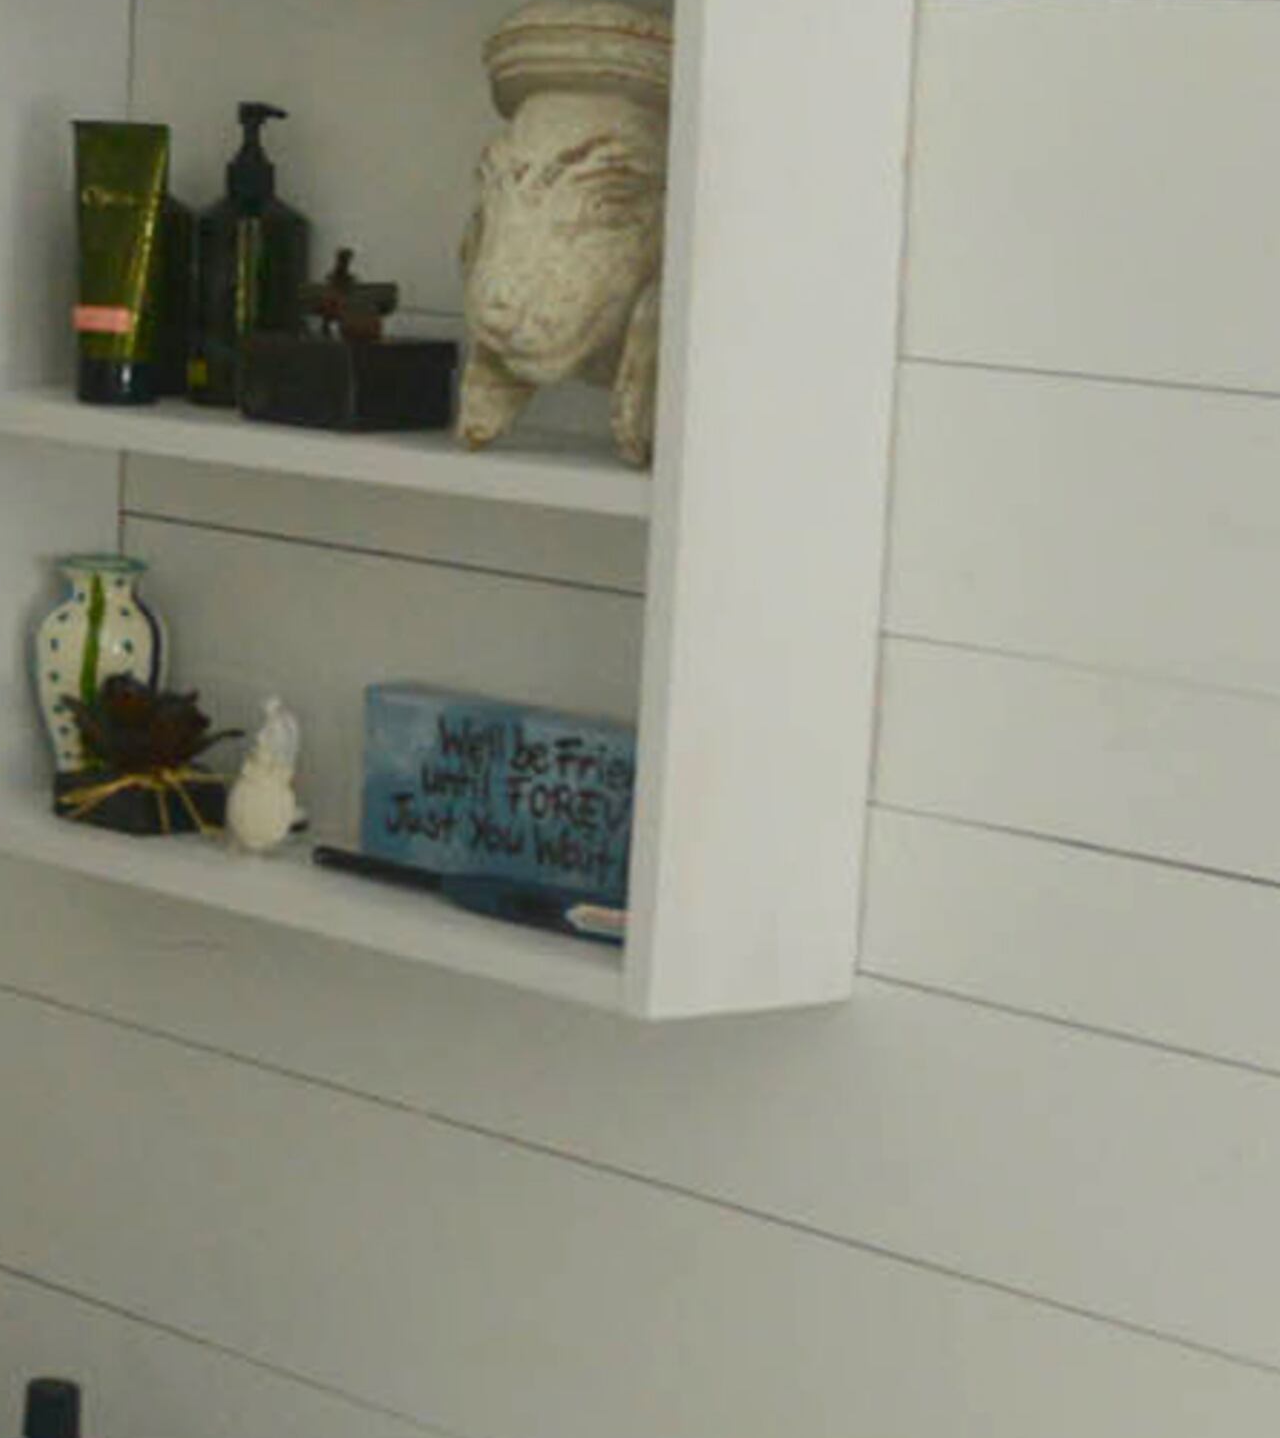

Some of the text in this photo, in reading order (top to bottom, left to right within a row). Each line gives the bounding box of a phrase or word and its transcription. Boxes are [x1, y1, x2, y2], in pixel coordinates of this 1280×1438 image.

[509, 722, 550, 774] be
[554, 734, 632, 792] Frie
[506, 774, 633, 834] FOREV
